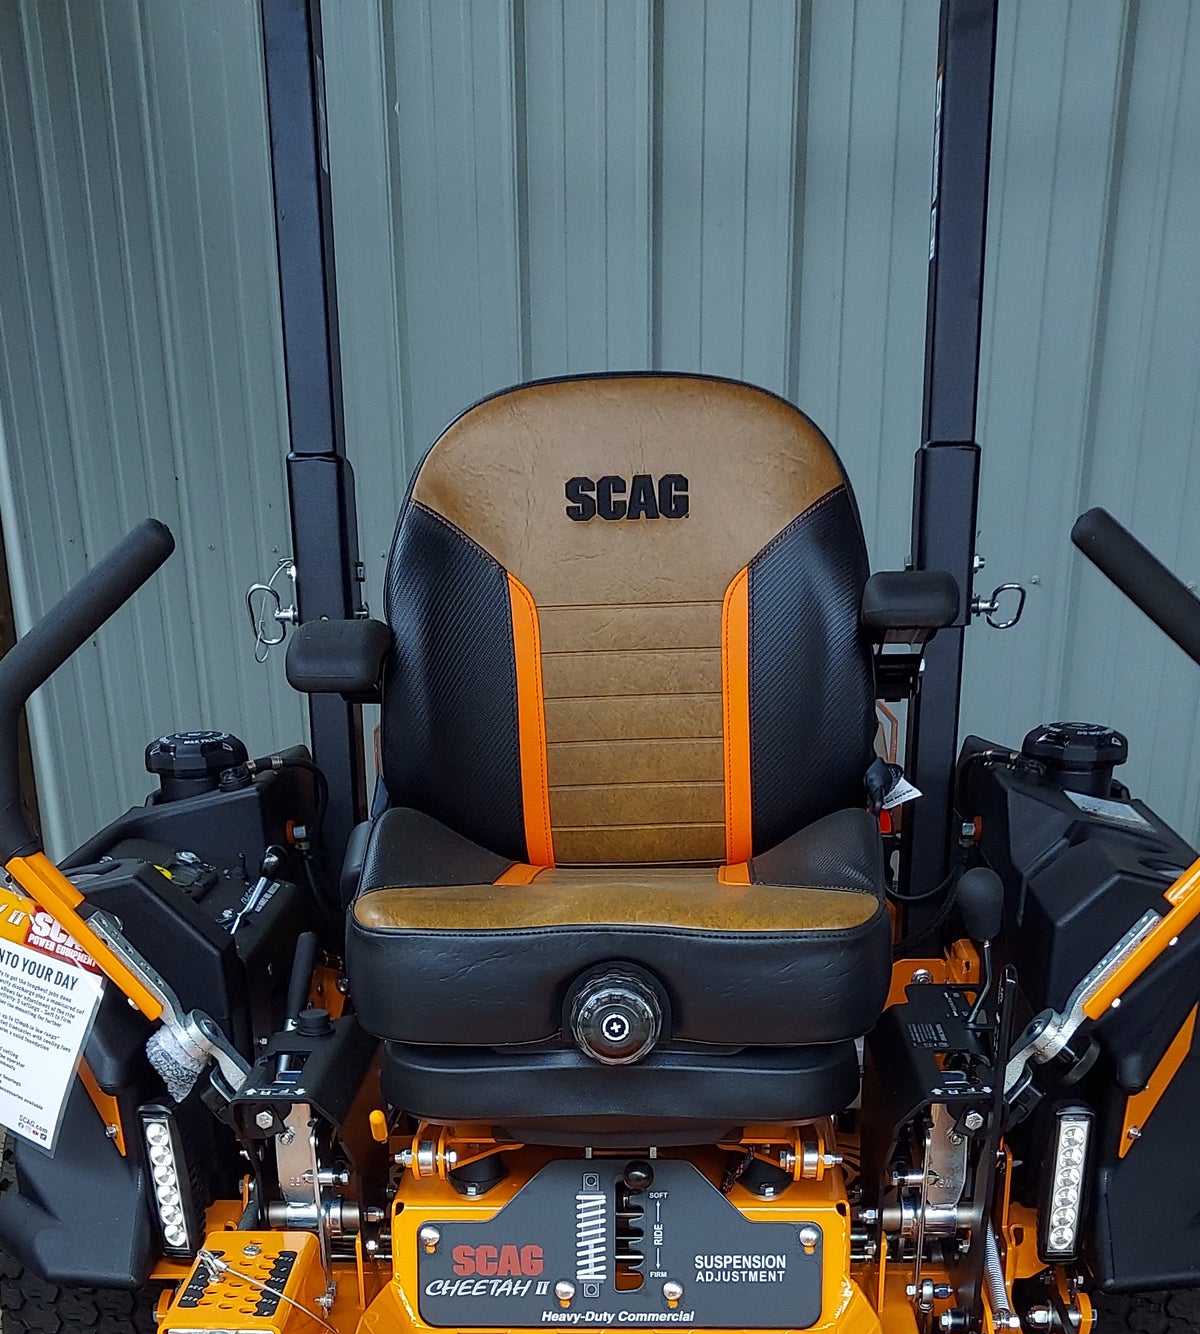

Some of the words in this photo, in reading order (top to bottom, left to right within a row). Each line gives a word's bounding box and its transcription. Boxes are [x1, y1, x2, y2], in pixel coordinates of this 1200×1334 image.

[565, 474, 689, 521] SCAG
[27, 933, 56, 951] POWER
[55, 944, 96, 967] EQUIPMENT
[21, 957, 53, 982] YOUR
[54, 970, 78, 990] DAY
[653, 1224, 663, 1246] RIDE
[452, 1245, 544, 1276] SCAG
[694, 1255, 786, 1268] SUSPENSION
[695, 1271, 785, 1282] ADJUSTMENT
[425, 1279, 532, 1297] CHEETAH
[535, 1281, 551, 1295] II
[542, 1311, 615, 1324] Heavy-Duty
[618, 1311, 695, 1322] Commercial
